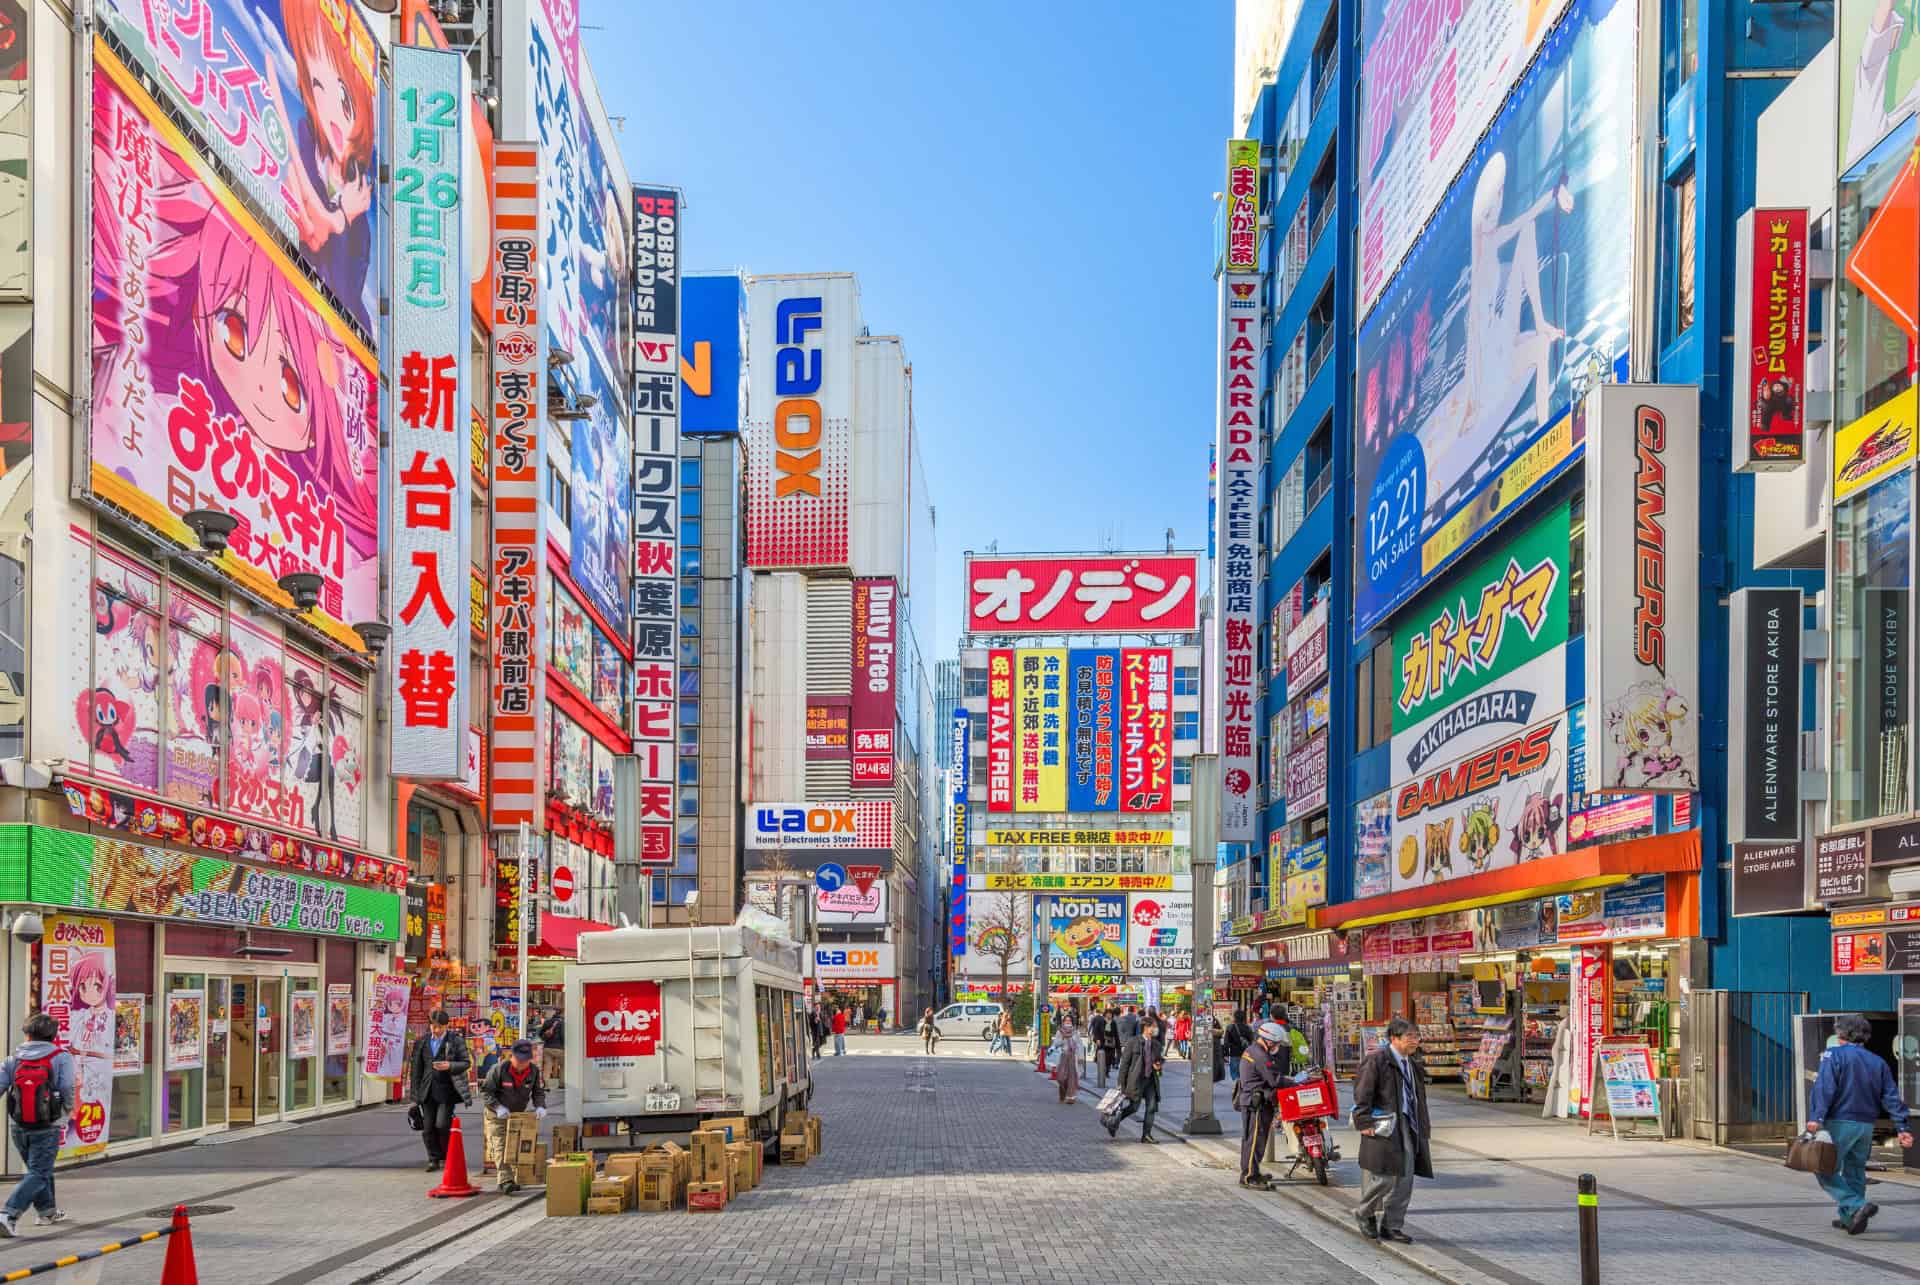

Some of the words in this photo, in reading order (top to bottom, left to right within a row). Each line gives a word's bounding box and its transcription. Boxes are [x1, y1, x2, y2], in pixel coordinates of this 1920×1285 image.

[656, 196, 675, 287] HOBBY
[1230, 165, 1256, 266] まんが喫茶
[497, 238, 536, 327] 買取り
[637, 196, 656, 328] PARADISE
[1767, 235, 1791, 374] カードキングダム
[1227, 317, 1255, 464] TAKARADA
[498, 372, 532, 474] まっくす
[399, 351, 458, 730] 新台入替
[1369, 466, 1418, 557] 12.21
[1371, 554, 1389, 582] ON
[1391, 525, 1417, 564] SALE
[1634, 403, 1667, 680] GAMERS
[973, 559, 1193, 623] オノデン
[1225, 543, 1254, 614] 免税商店
[500, 547, 531, 714] アキバ駅前店
[867, 585, 895, 639] Duty
[1766, 607, 1780, 659] AKIBA
[856, 635, 868, 668] Store
[868, 642, 894, 693] Free
[1765, 663, 1779, 719] STORE
[990, 702, 1011, 744] TAX
[1419, 692, 1518, 758] AKIHABARA
[953, 717, 967, 794] Panasonic
[990, 747, 1011, 803] FREE
[1396, 720, 1562, 822] GAMERS
[1764, 724, 1779, 823] ALIENWARE
[1128, 793, 1162, 810] 4F
[783, 834, 831, 845] Electronics
[832, 834, 858, 845] Store
[954, 803, 966, 865] ONODEN
[994, 832, 1025, 844] TAX
[1030, 832, 1071, 844] FREE
[1073, 832, 1112, 844] 免税店
[1743, 845, 1796, 861] ALIENWARE
[1836, 853, 1865, 866] IDEAL
[1070, 878, 1115, 888] エアコン
[1743, 862, 1770, 874] STORE
[1771, 858, 1796, 870] AKIBA
[270, 902, 296, 926] OF
[298, 908, 341, 931] GOLD
[1133, 956, 1193, 969] ONODEN
[1288, 934, 1331, 962] TAKARADA
